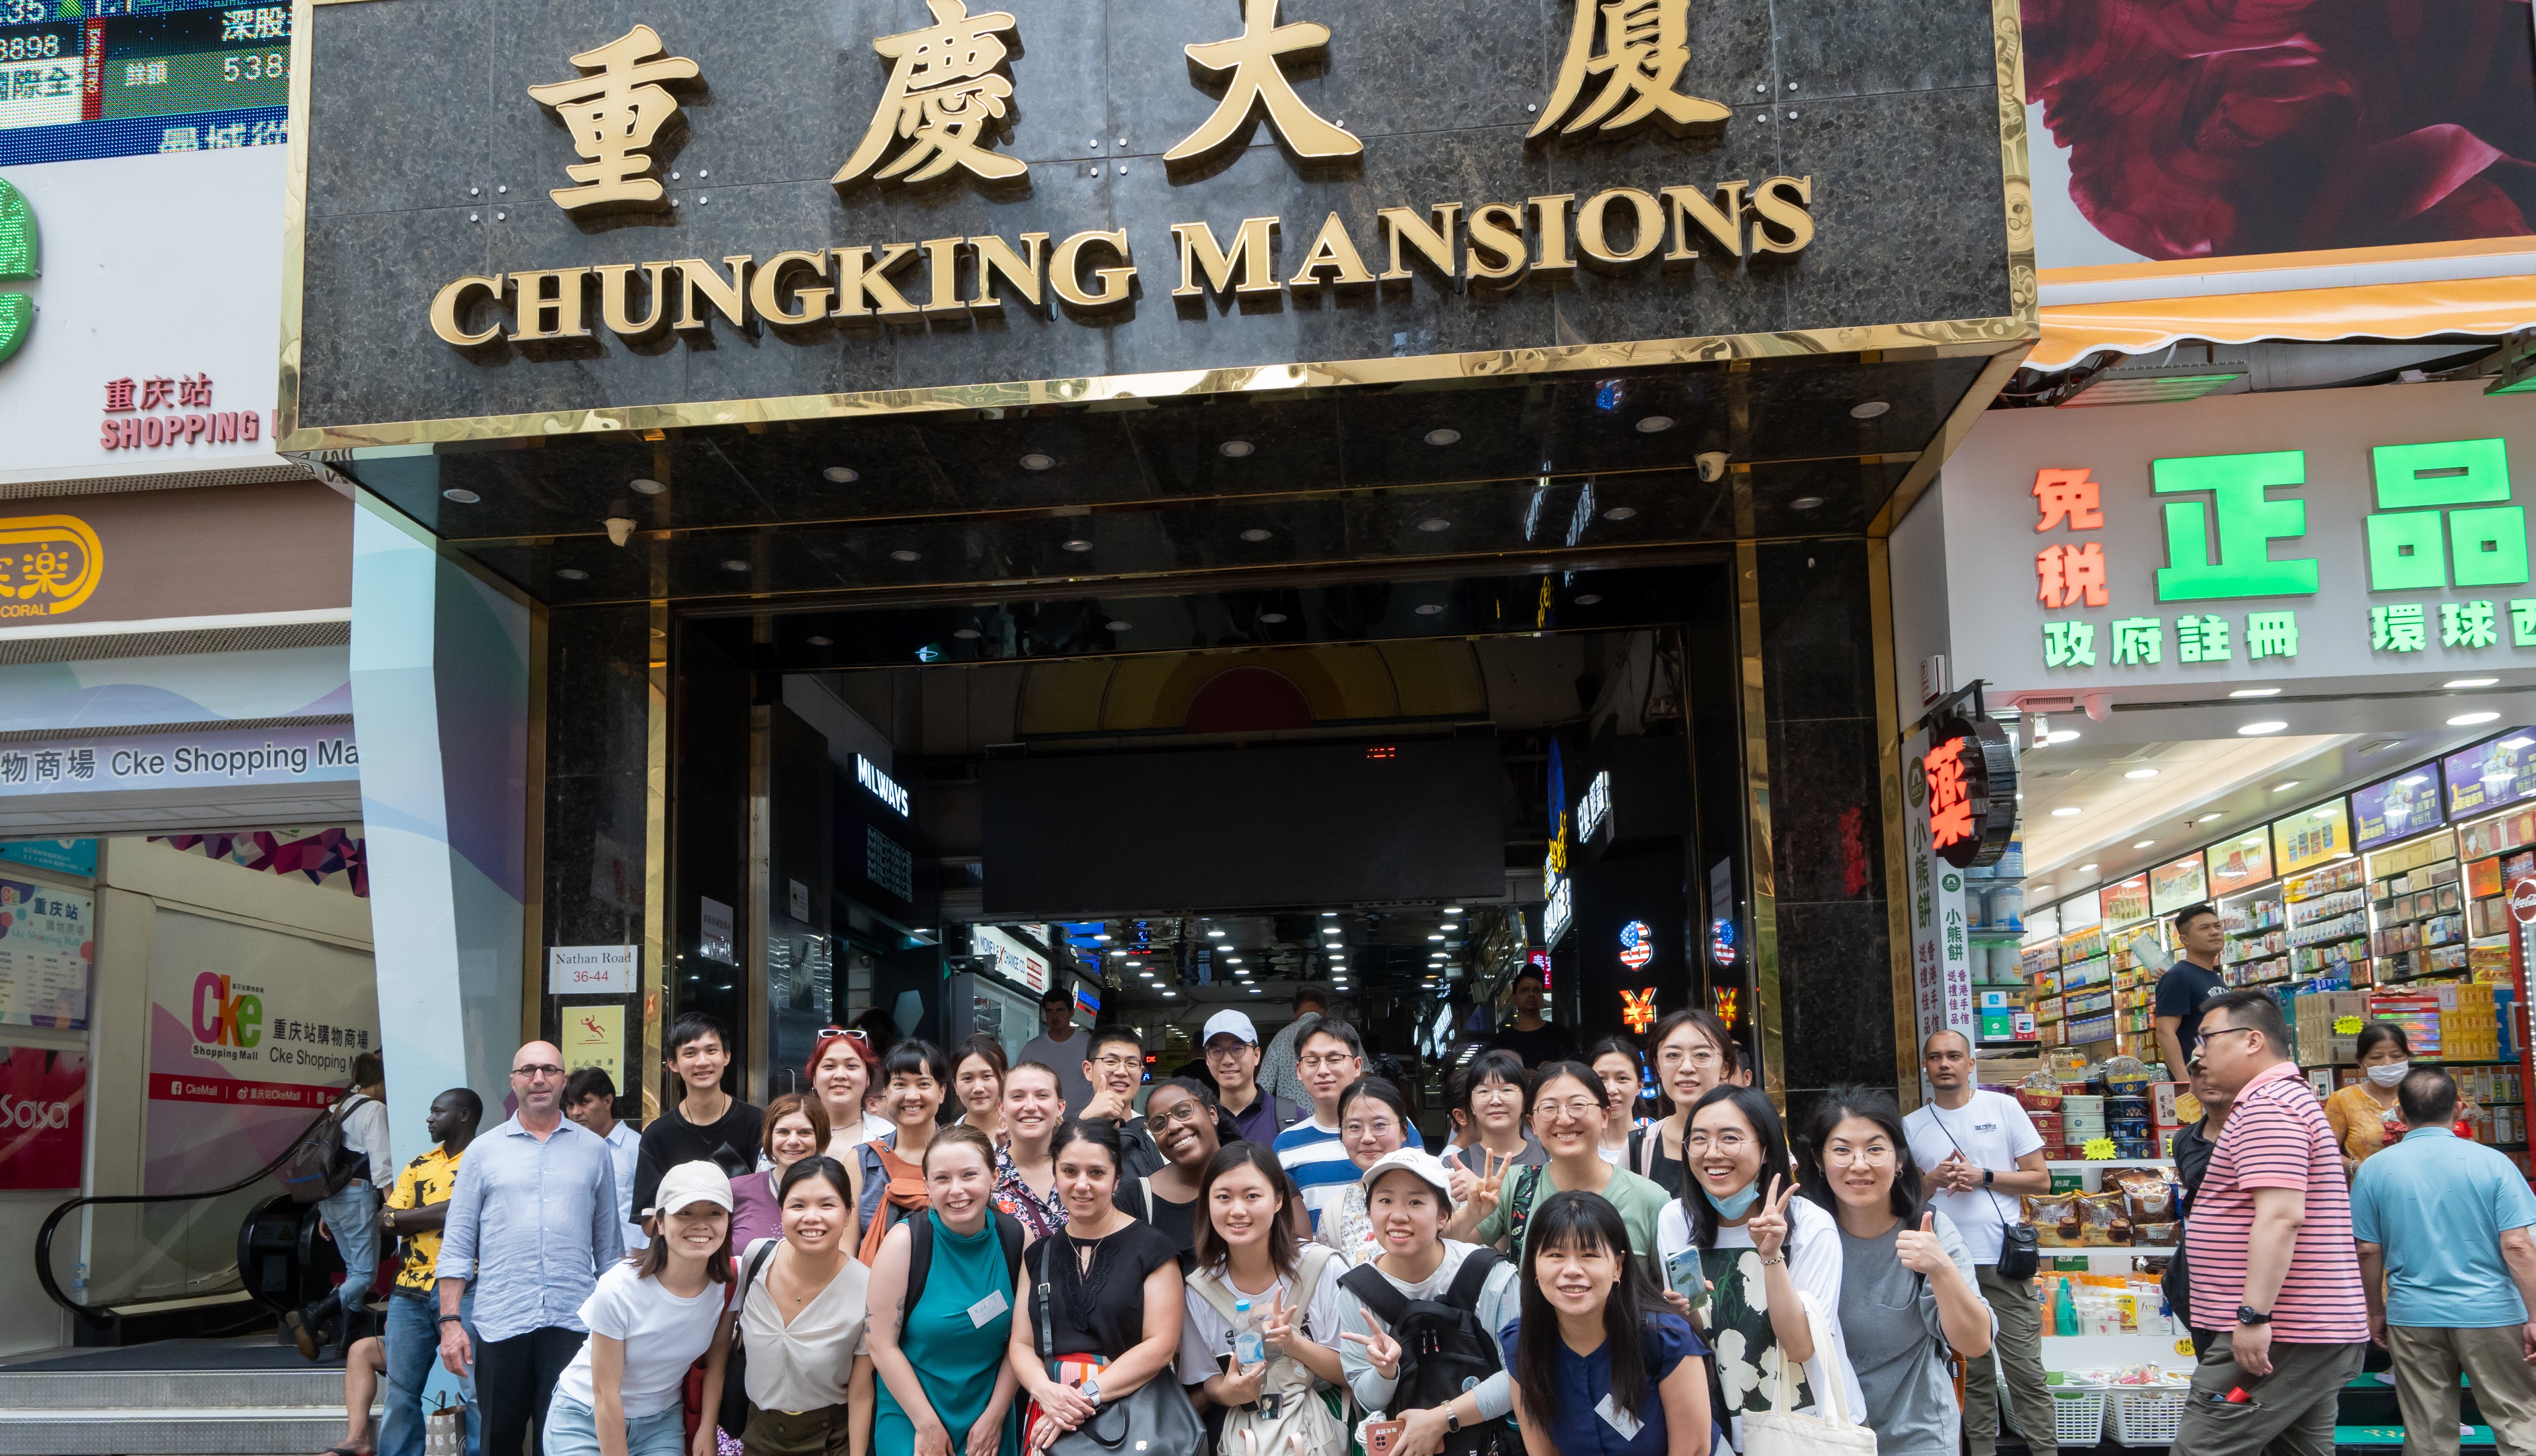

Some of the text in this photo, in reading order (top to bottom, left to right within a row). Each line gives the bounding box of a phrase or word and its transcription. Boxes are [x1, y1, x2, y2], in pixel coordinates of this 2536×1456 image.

[430, 174, 1815, 347] CHUNGKING MANSIONS
[102, 372, 214, 413] 重庆站
[100, 410, 259, 450] SHOPPING
[2150, 438, 2530, 603] 正品
[0, 603, 48, 619] CORAL
[2043, 610, 2299, 669] 政府註冊
[1, 749, 96, 783] 物商場
[111, 751, 165, 776] Cke
[173, 744, 308, 777] Shopping
[857, 753, 909, 818] MILWAYS
[1913, 817, 1931, 930] 小熊餅
[33, 897, 78, 921] 重庆站
[980, 934, 995, 956] MONEY
[1945, 908, 1964, 962] 小熊餅
[556, 952, 631, 965] Nathan Road
[573, 970, 609, 982] 36-44
[192, 971, 263, 1049] Cke
[1947, 970, 1959, 1025] 送禮佳品
[1958, 969, 1970, 1025] 香港手信
[273, 1018, 369, 1050] 重庆站購物商場
[193, 1045, 258, 1061] Shopping Mall
[270, 1046, 293, 1065] Cke
[297, 1049, 346, 1073] Shopping
[186, 1083, 218, 1096] CkeMall
[250, 1088, 301, 1101] 重庆站CkeMall
